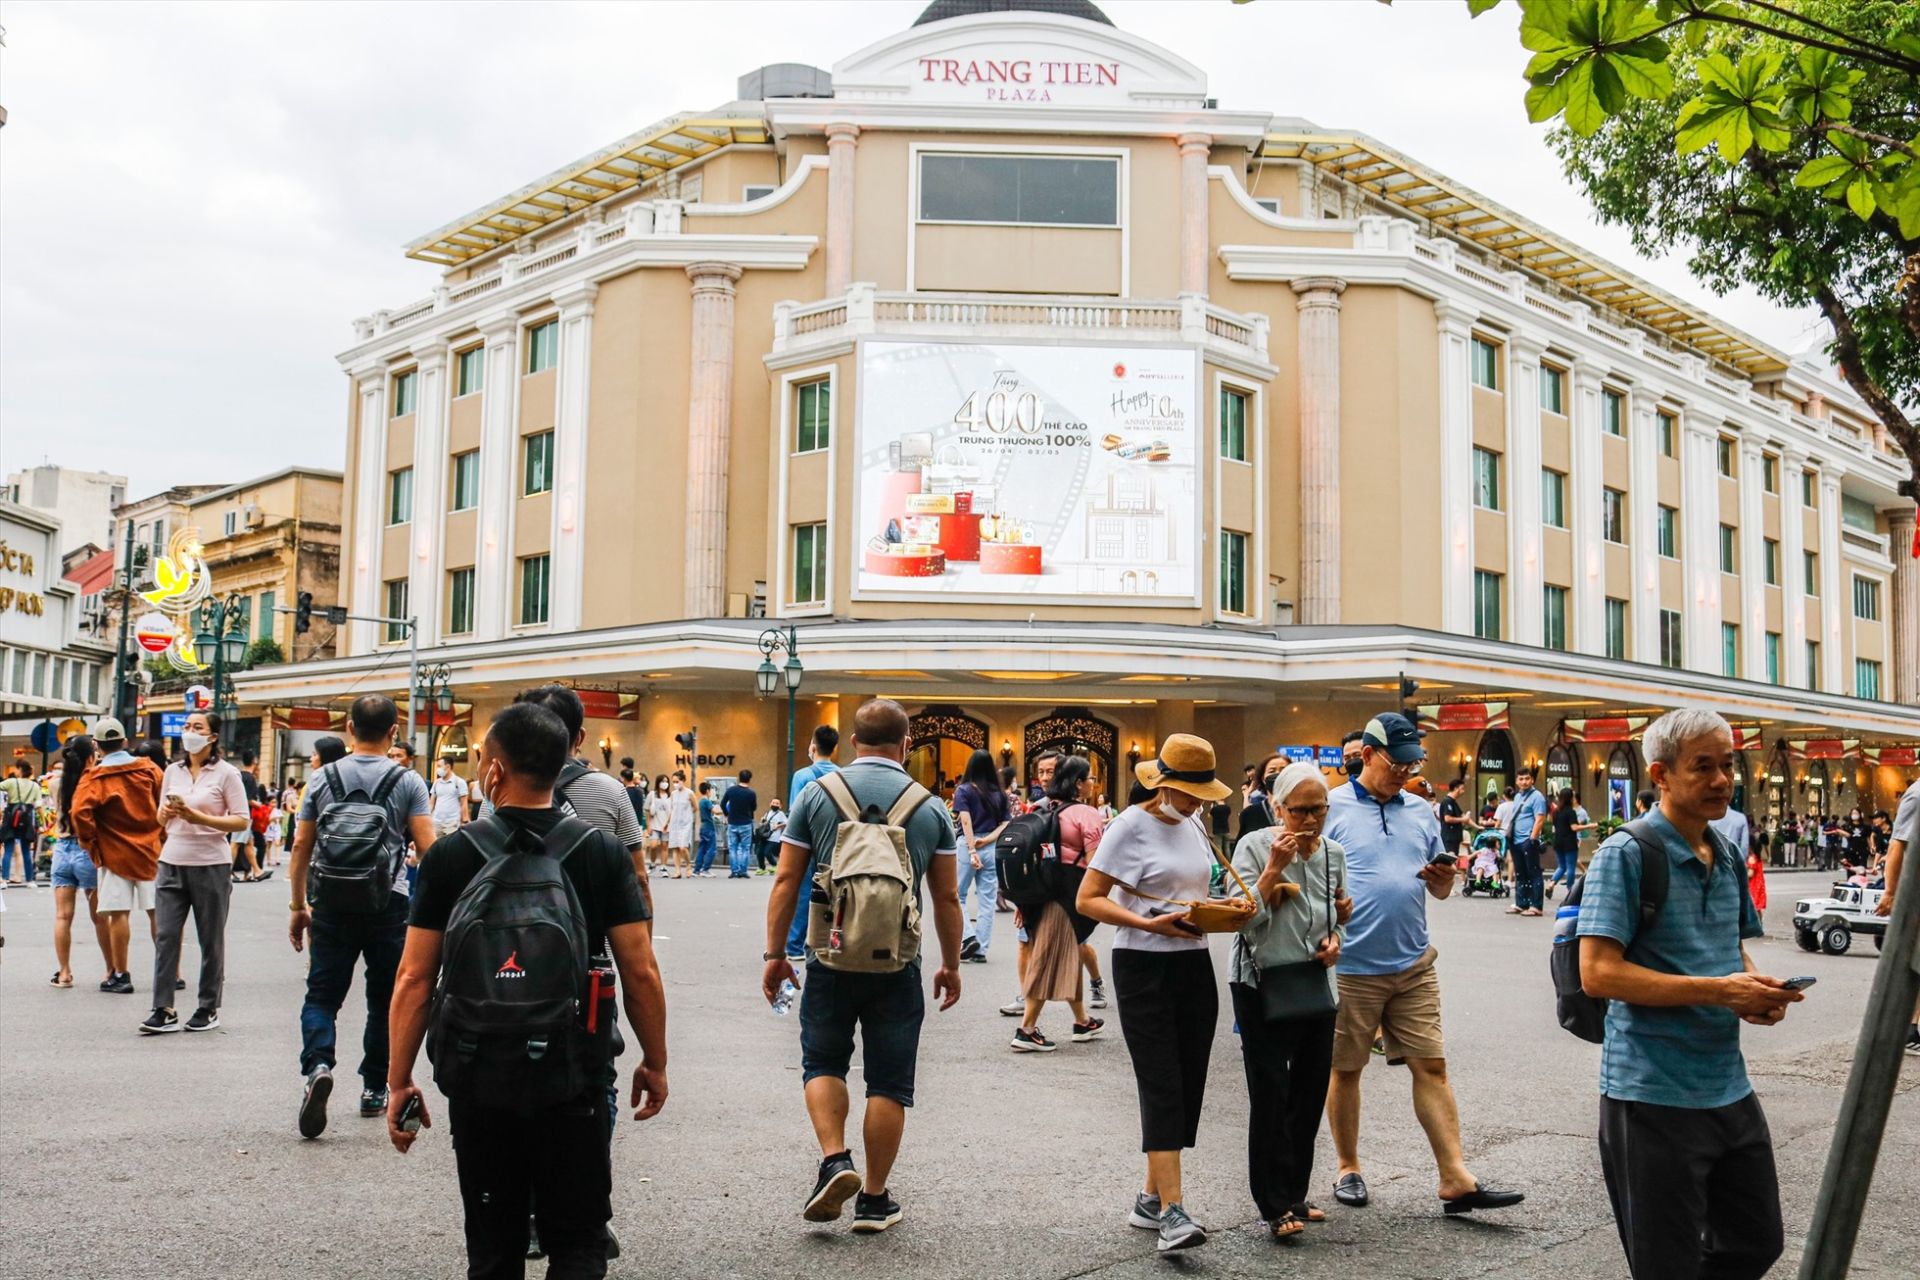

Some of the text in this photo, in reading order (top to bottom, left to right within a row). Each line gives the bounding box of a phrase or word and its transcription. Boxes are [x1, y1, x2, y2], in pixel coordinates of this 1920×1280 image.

[919, 59, 1119, 86] TRANG TIEN
[987, 87, 1052, 102] PLAZA
[1110, 389, 1149, 419] Happy
[954, 390, 1044, 434] 400
[1064, 422, 1088, 431] CAO
[1045, 434, 1092, 448] 100%
[1480, 759, 1503, 769] HUBLOT
[1549, 763, 1569, 772] GUCCI
[1610, 766, 1628, 775] GUCCI
[495, 970, 525, 979] JORDAN
